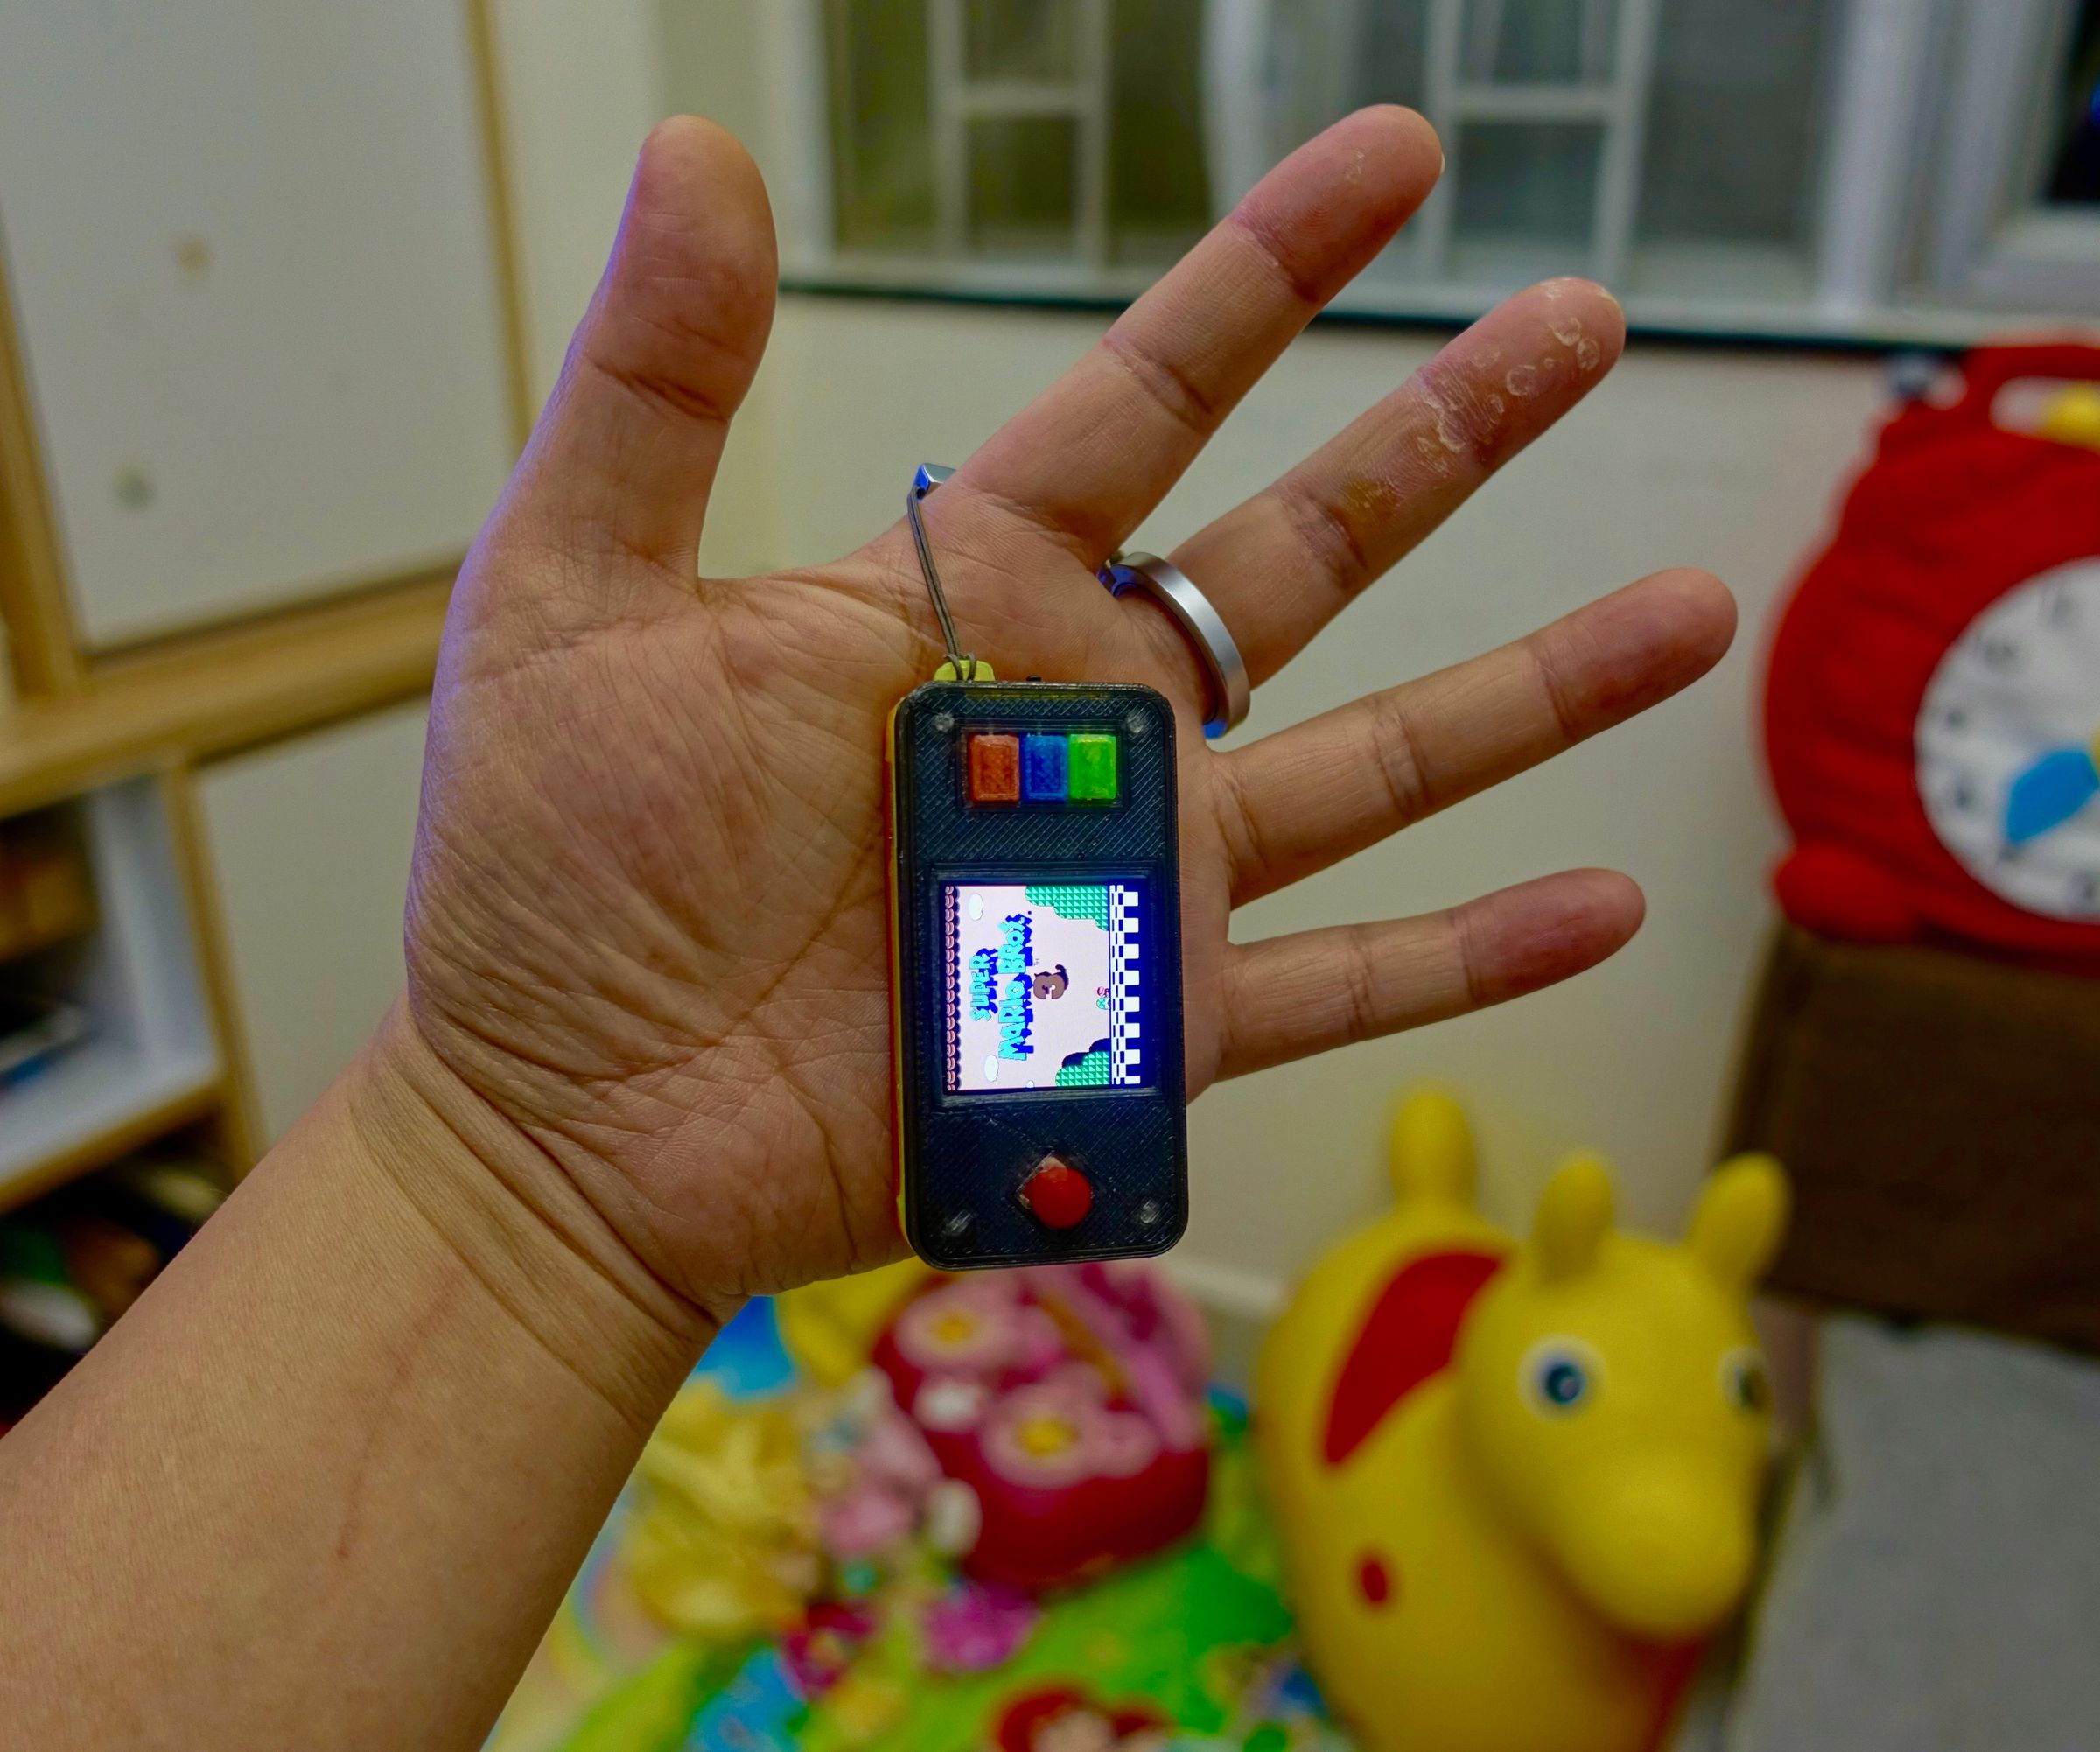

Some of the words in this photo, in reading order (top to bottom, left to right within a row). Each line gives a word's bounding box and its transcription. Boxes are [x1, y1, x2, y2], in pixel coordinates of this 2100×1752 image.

[970, 948, 998, 1021] SUPER
[998, 975, 1033, 1061] MARIO
[1033, 970, 1067, 999] 3
